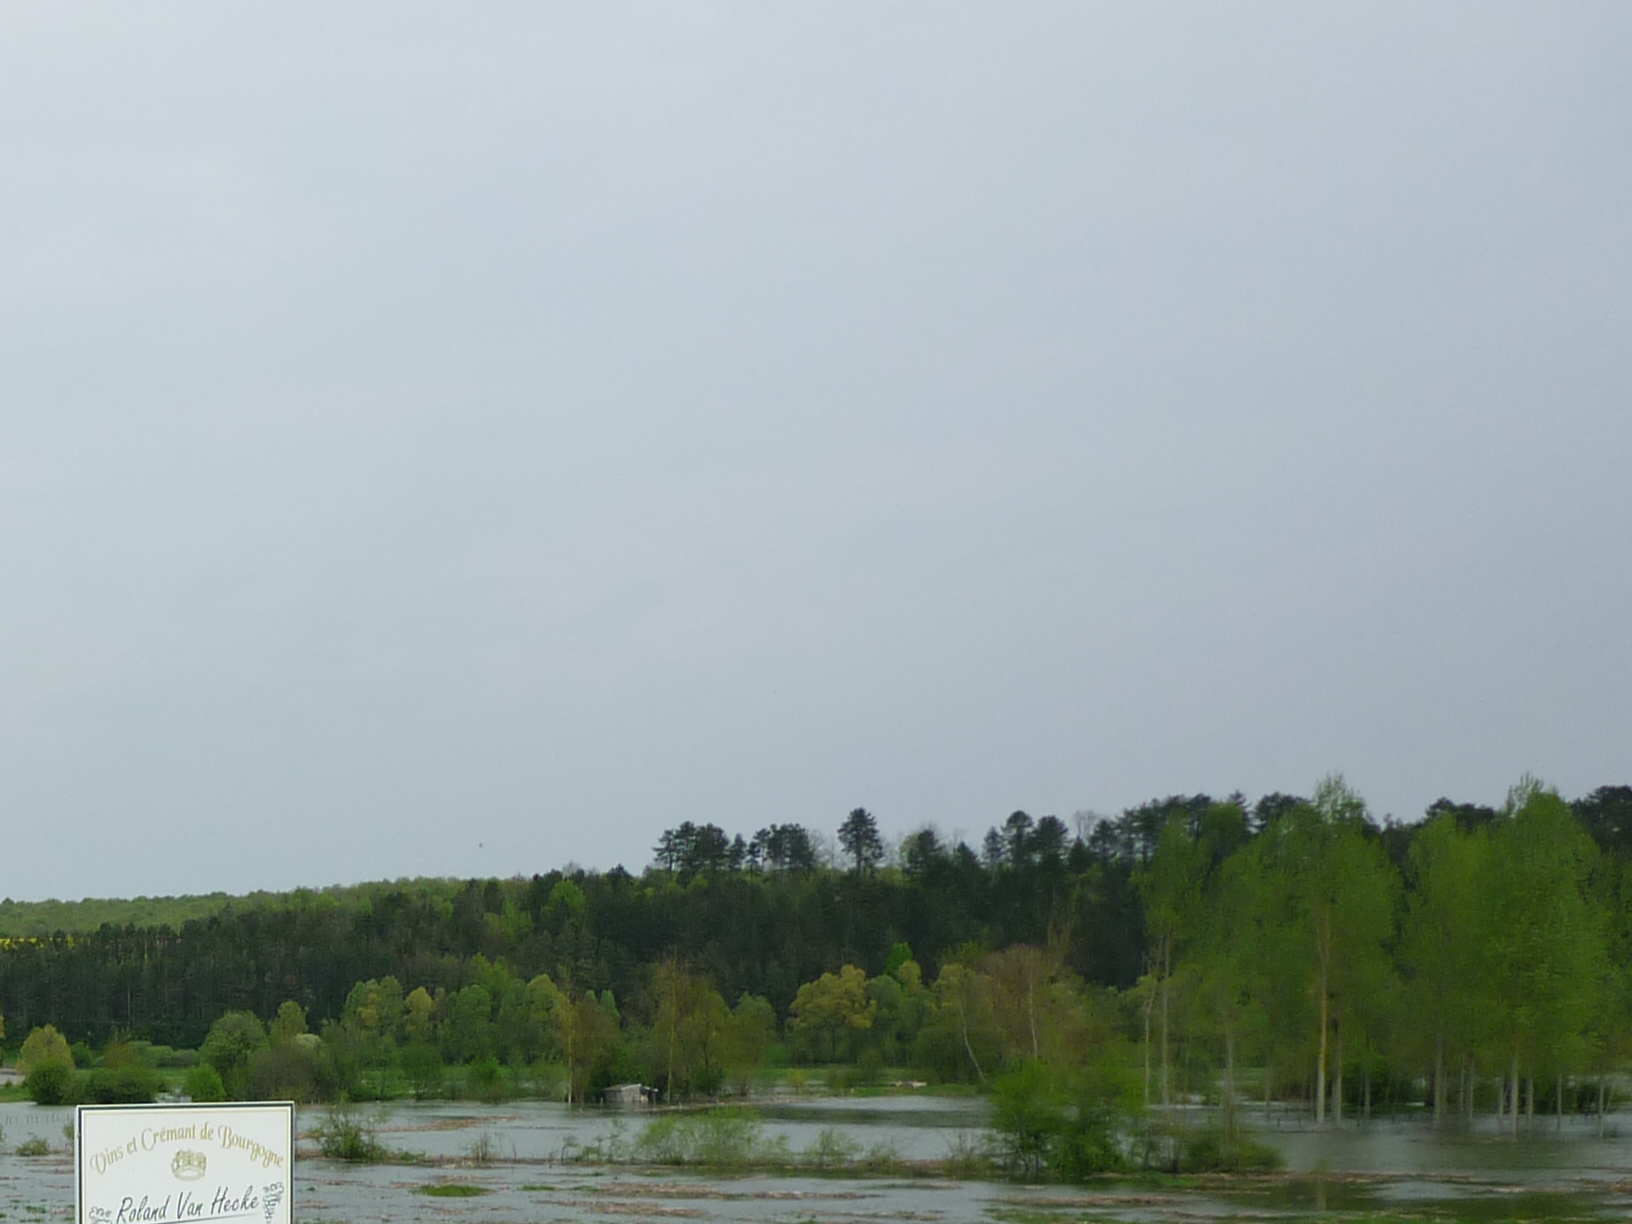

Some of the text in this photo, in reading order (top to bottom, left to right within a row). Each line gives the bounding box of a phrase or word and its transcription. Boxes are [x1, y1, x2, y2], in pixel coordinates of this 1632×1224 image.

[90, 1122, 284, 1174] Vins et Crémant de Bourgogne
[115, 1185, 259, 1224] Roland Van Hecke
